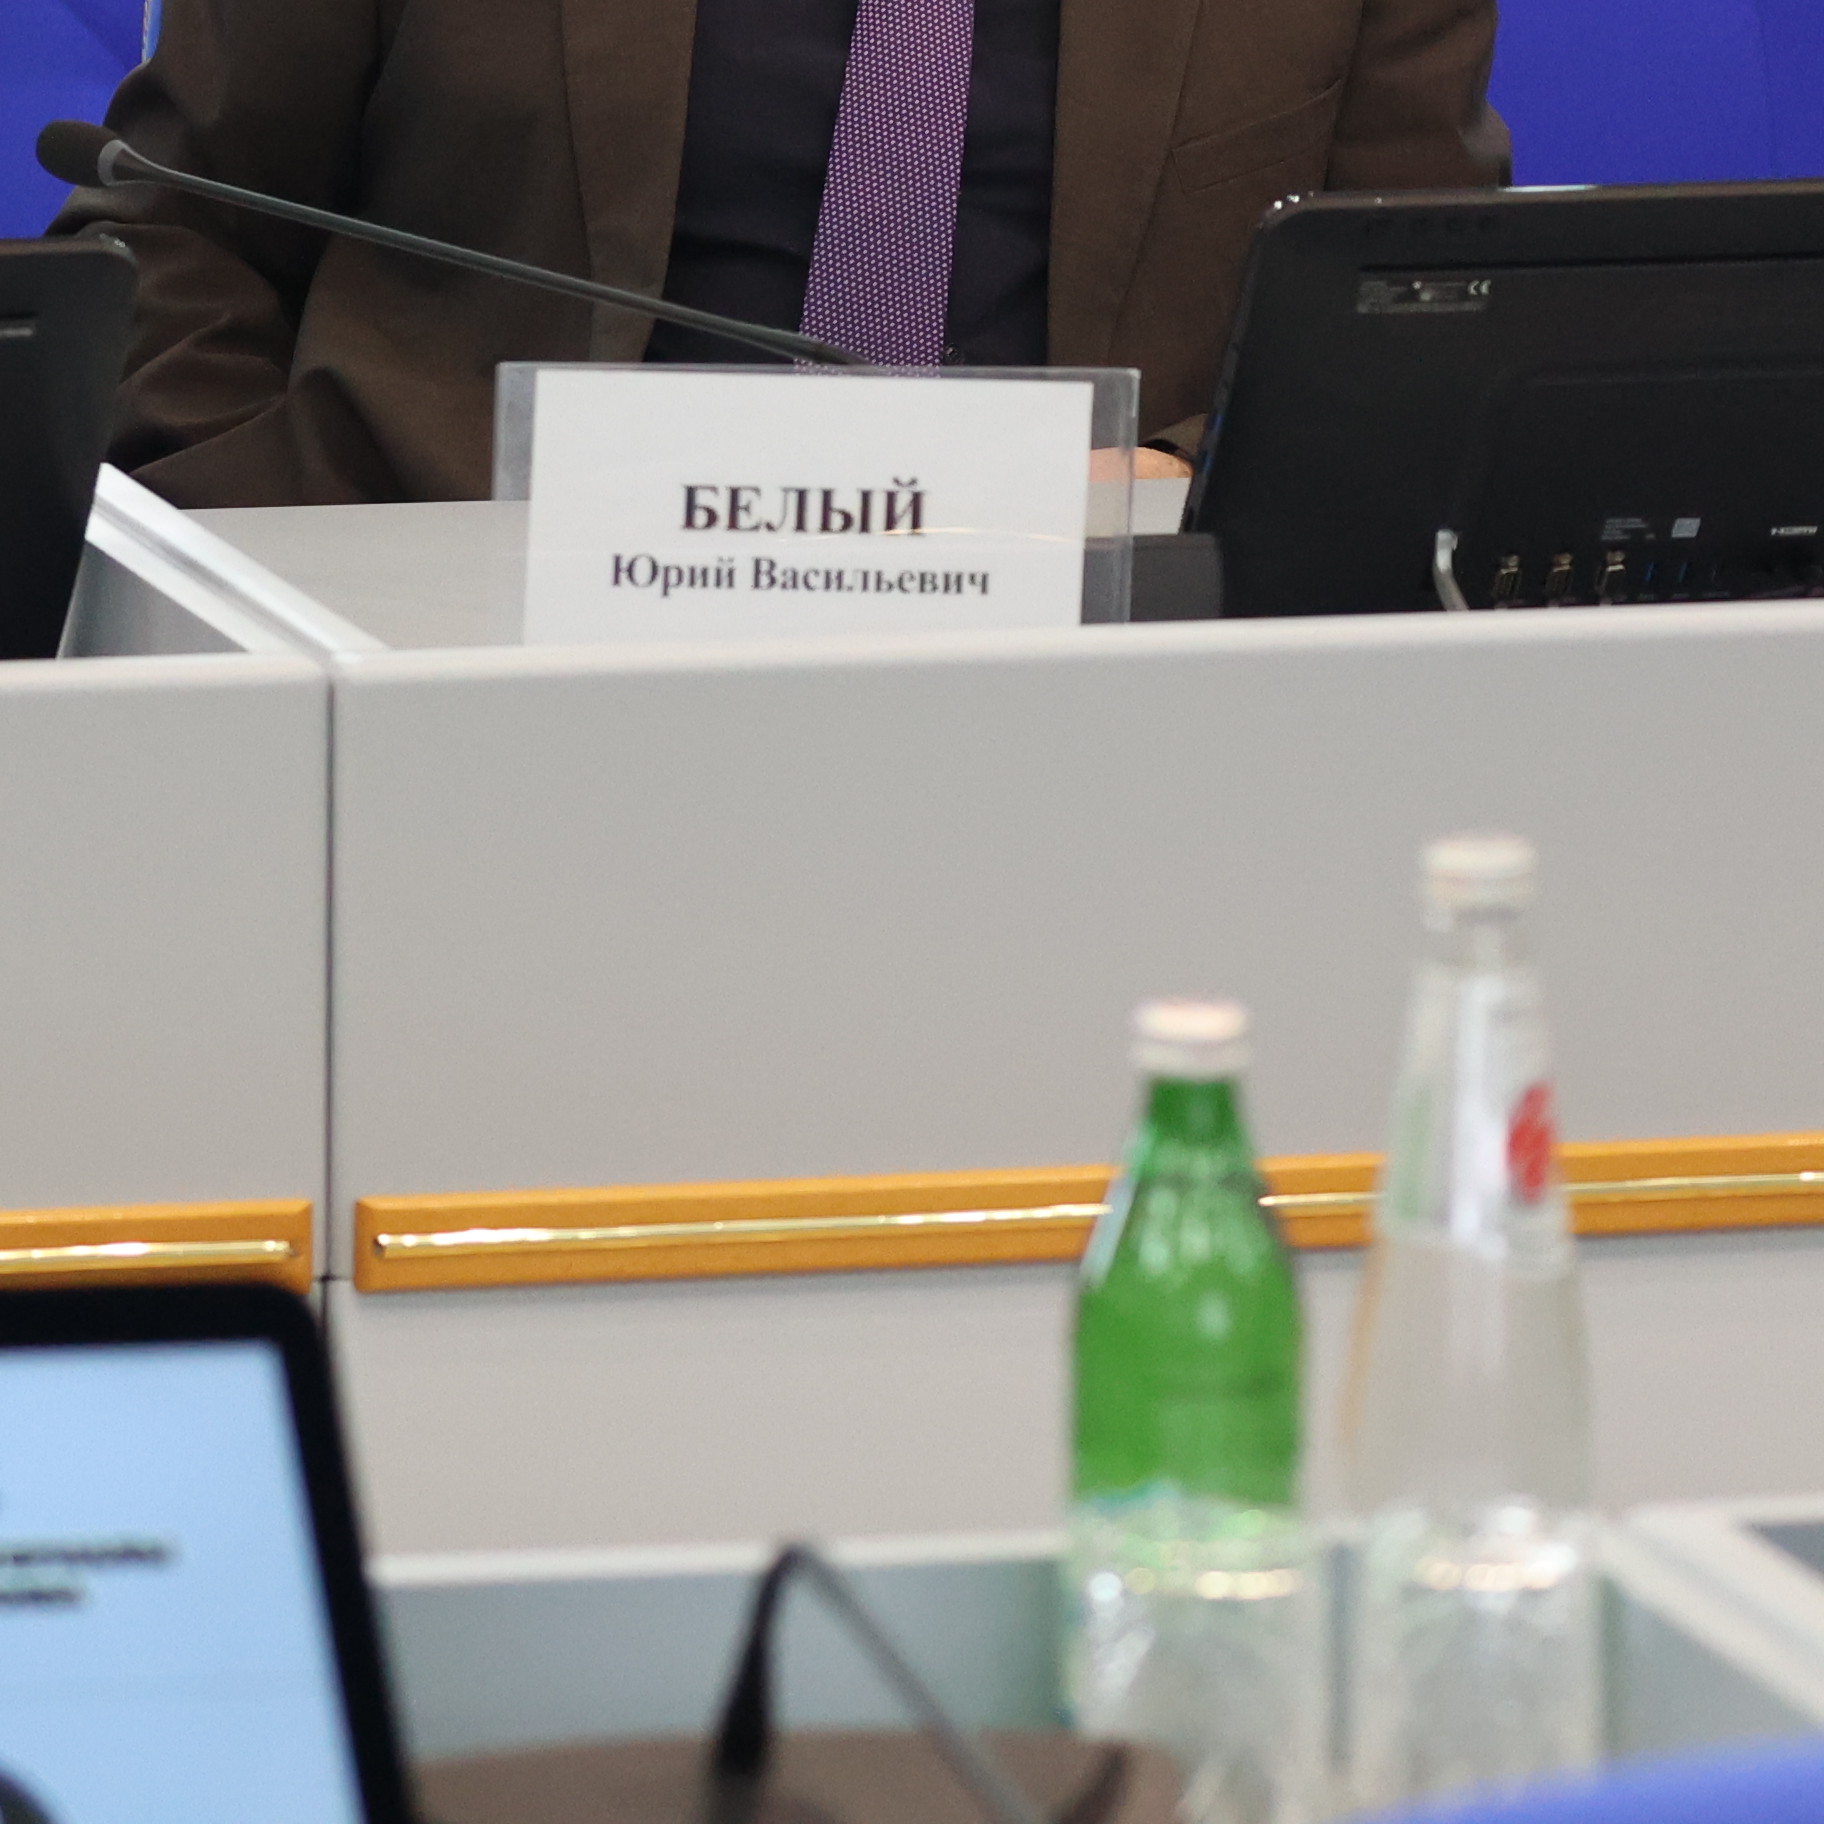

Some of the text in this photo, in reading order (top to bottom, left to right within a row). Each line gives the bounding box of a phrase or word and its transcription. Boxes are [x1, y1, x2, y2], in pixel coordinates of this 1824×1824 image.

[682, 476, 926, 537] БЕЛЫЙ
[612, 555, 990, 597] Юрий Васильевич
